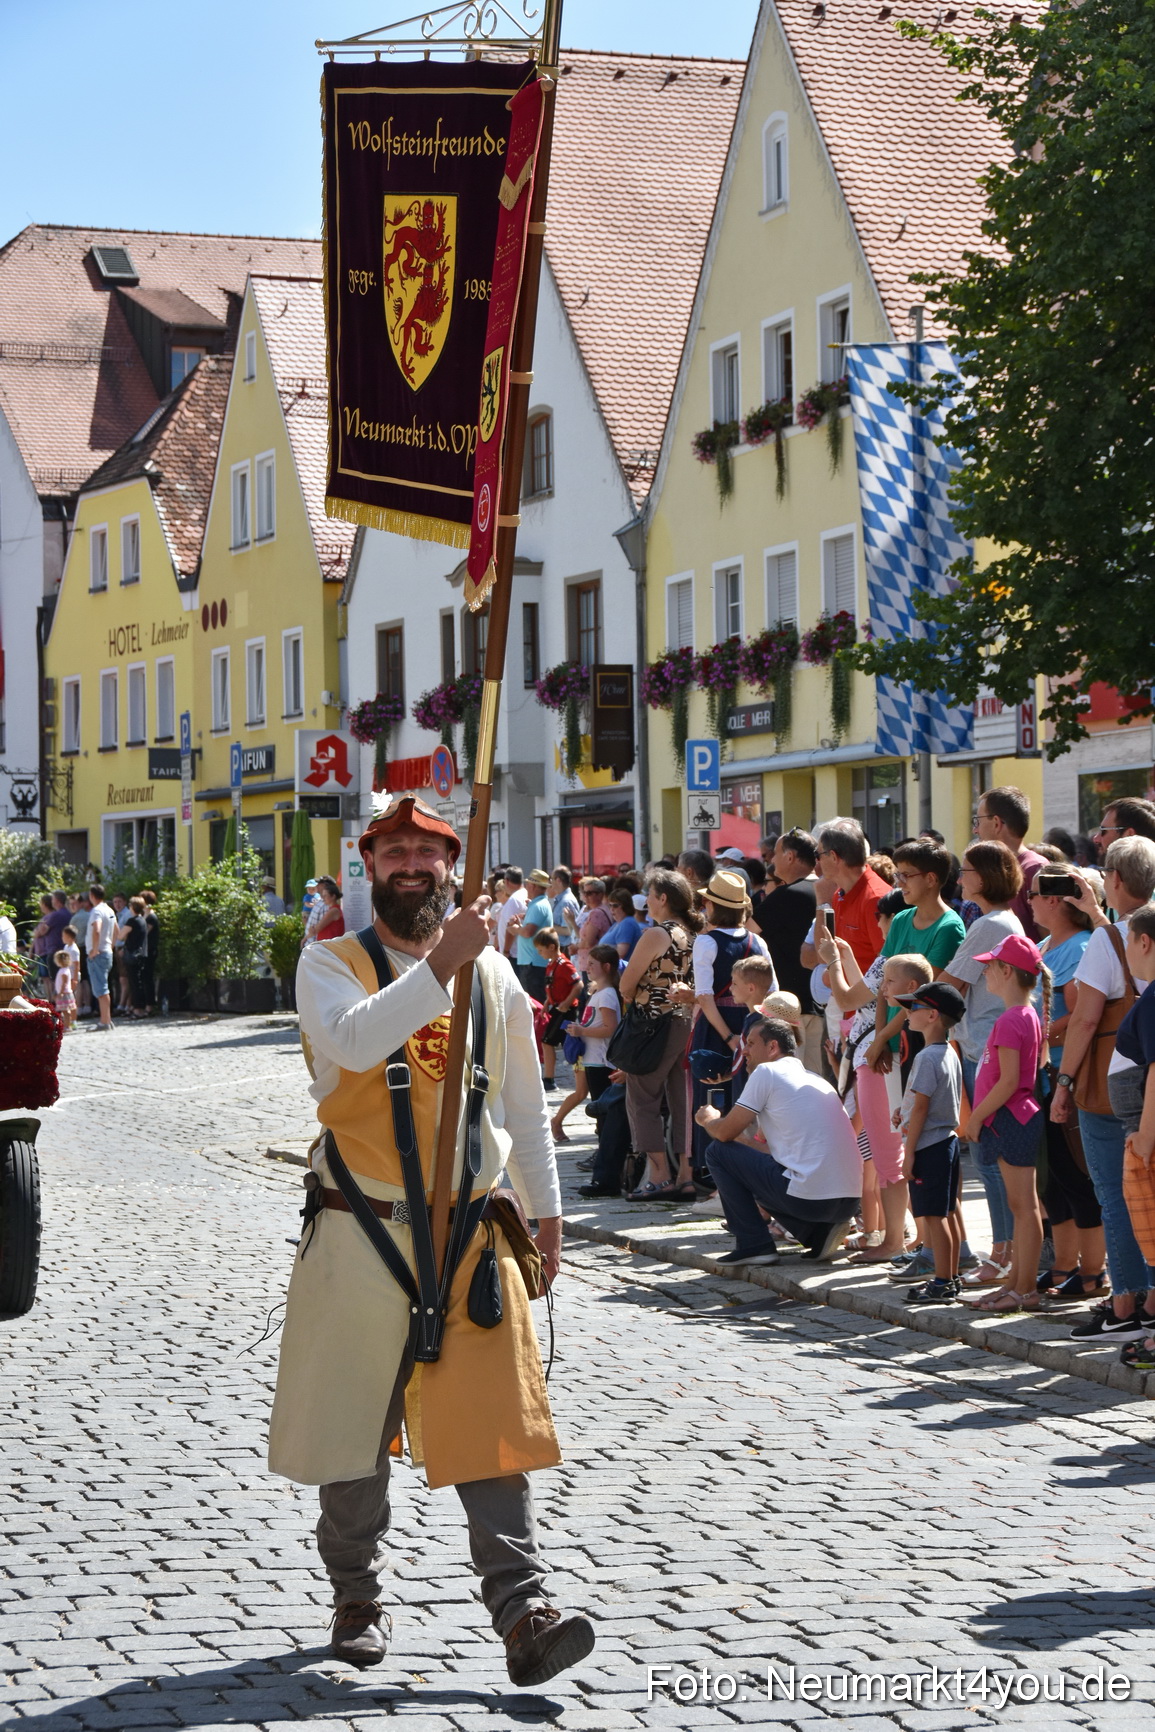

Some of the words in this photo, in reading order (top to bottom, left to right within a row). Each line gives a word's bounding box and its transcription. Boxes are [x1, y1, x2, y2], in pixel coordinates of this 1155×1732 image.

[348, 116, 507, 174] Wolfsteinfreunde
[348, 268, 377, 295] gegr.
[343, 406, 426, 449] Neumarkt
[108, 623, 143, 658] HOTEL
[151, 616, 190, 646] Lehmeier
[182, 718, 189, 750] P
[752, 710, 771, 726] MEHR
[232, 749, 240, 782] P
[693, 746, 712, 786] P
[106, 783, 155, 807] Restaurant
